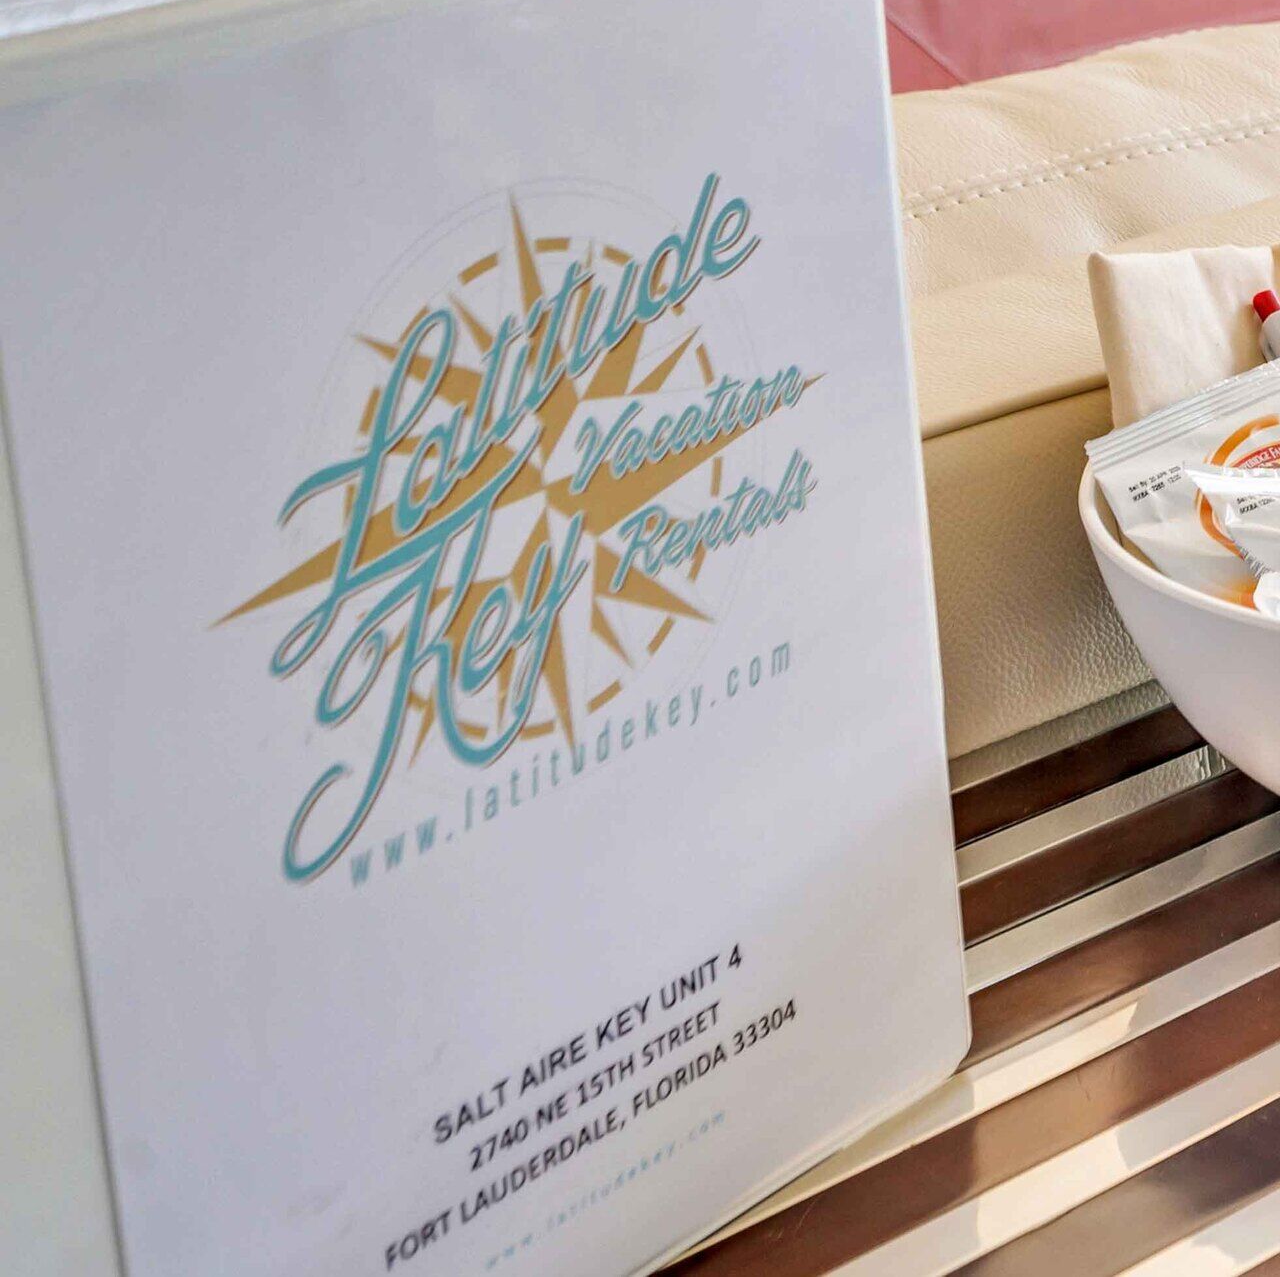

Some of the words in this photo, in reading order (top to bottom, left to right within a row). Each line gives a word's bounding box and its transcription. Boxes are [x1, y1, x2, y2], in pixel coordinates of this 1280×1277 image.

[268, 172, 761, 679] Latitude
[572, 364, 803, 494] Vacation
[609, 448, 819, 592] Rentals
[281, 501, 588, 883] Key
[349, 638, 793, 889] www.latitudekey.com
[384, 1207, 453, 1273] FORT
[459, 1106, 626, 1225] LAUDERDALE,
[633, 1042, 728, 1118] FLORIDA
[732, 998, 798, 1056] 33304
[433, 1078, 510, 1144] SALT
[519, 1033, 588, 1098] AIRE
[595, 994, 651, 1052] KEY
[660, 953, 720, 1011] UNIT
[728, 942, 742, 969] 4
[469, 1117, 529, 1172] 2740
[536, 1090, 570, 1132] NE
[577, 1051, 635, 1108] 15TH
[642, 998, 720, 1068] STREET
